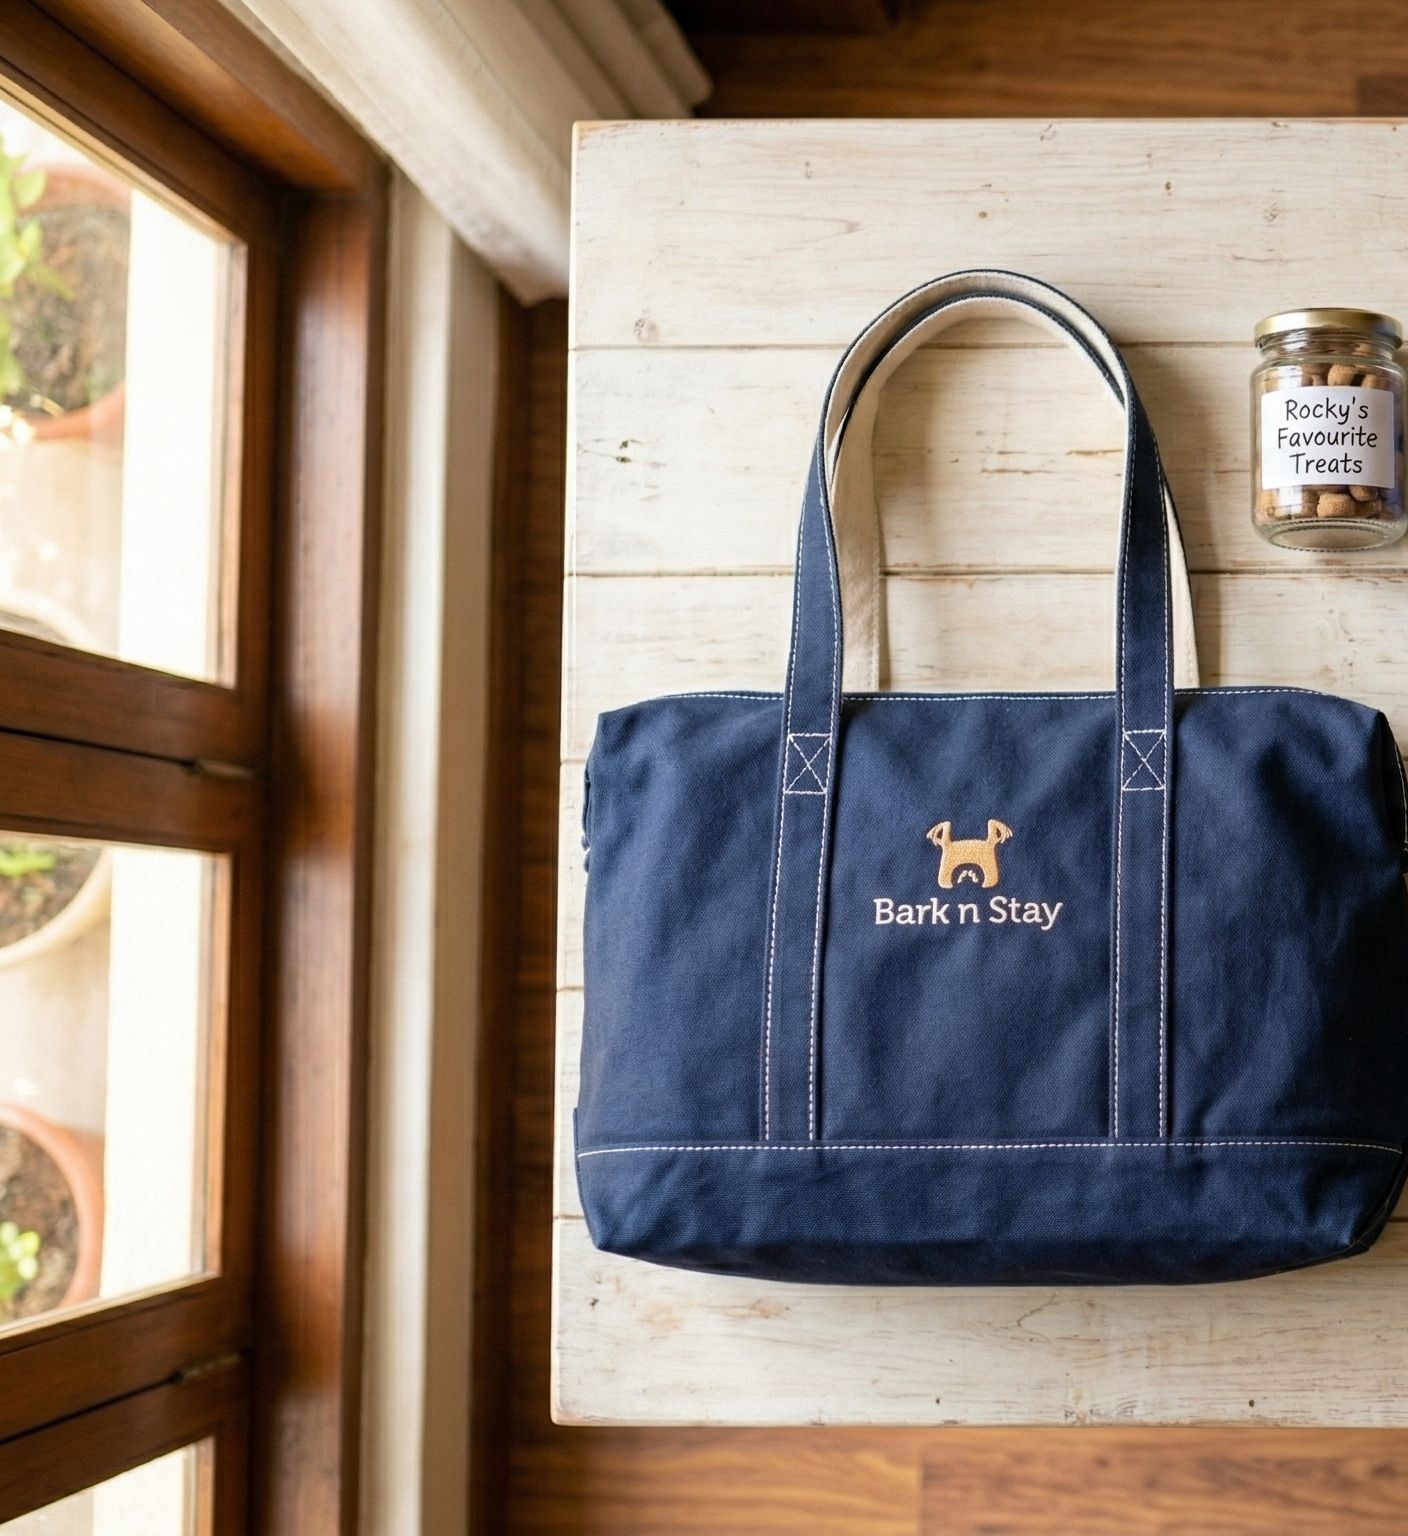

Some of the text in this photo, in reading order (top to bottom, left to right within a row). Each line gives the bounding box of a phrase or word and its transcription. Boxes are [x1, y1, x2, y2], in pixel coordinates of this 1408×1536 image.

[1284, 396, 1369, 425] Rocky's
[1277, 426, 1378, 449] Favourite
[1289, 453, 1363, 475] Treats
[873, 896, 1063, 931] Bark n Stay
